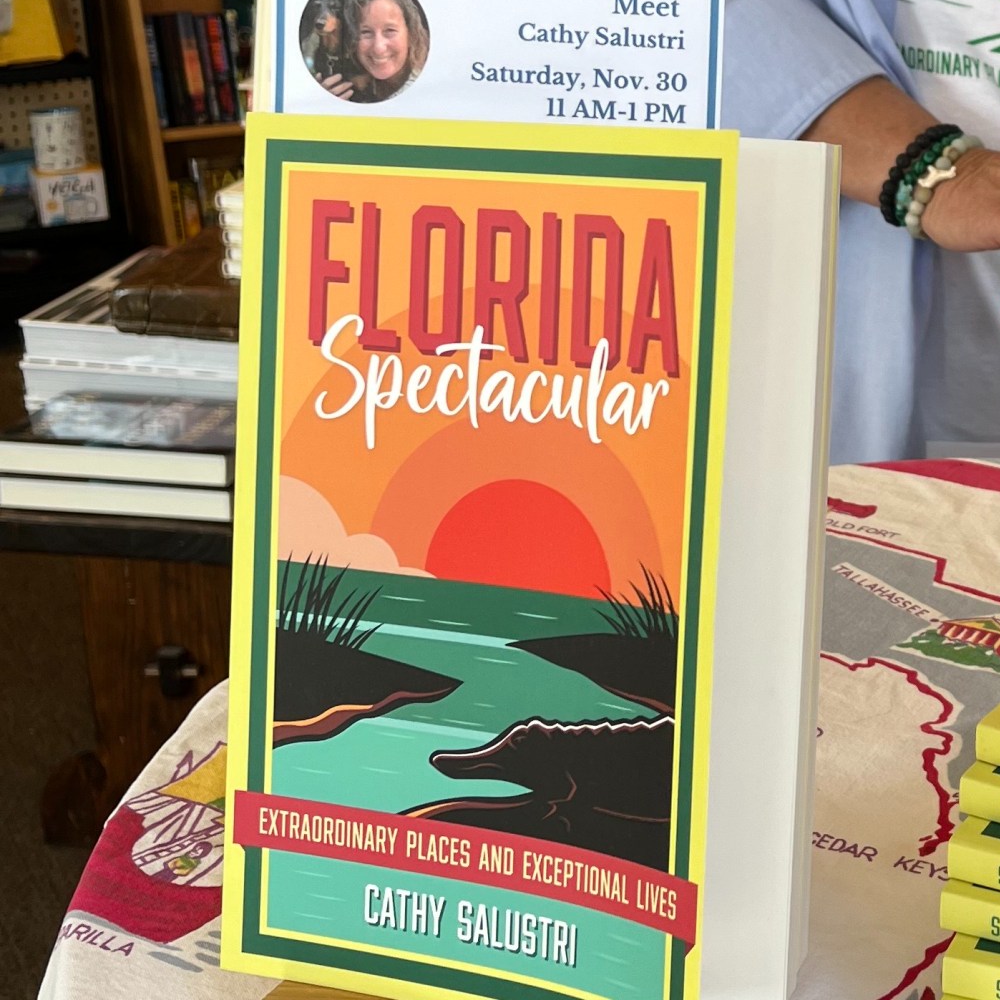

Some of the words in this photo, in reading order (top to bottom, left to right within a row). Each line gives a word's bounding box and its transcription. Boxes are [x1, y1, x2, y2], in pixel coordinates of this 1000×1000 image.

[518, 22, 589, 49] Cathy
[595, 26, 686, 50] Salustri
[470, 61, 586, 91] Saturday,
[593, 68, 649, 91] Nov.
[656, 72, 688, 92] 30
[546, 97, 566, 117] 11
[571, 98, 636, 121] AM-1
[644, 102, 687, 124] PM
[308, 199, 681, 379] FLORIDA
[314, 313, 670, 450] Spectacular
[858, 527, 901, 540] FORT
[833, 563, 931, 620] TALLAHASSEE
[259, 807, 399, 856] EXTRAORDINARY
[405, 830, 471, 868] PLACES
[479, 842, 514, 876] AND
[522, 851, 630, 906] EXCEPTIONAL
[636, 878, 678, 921] LIVES
[60, 922, 135, 957] ARILLA
[364, 883, 447, 938] CATHY
[457, 900, 577, 968] SALUSTRI
